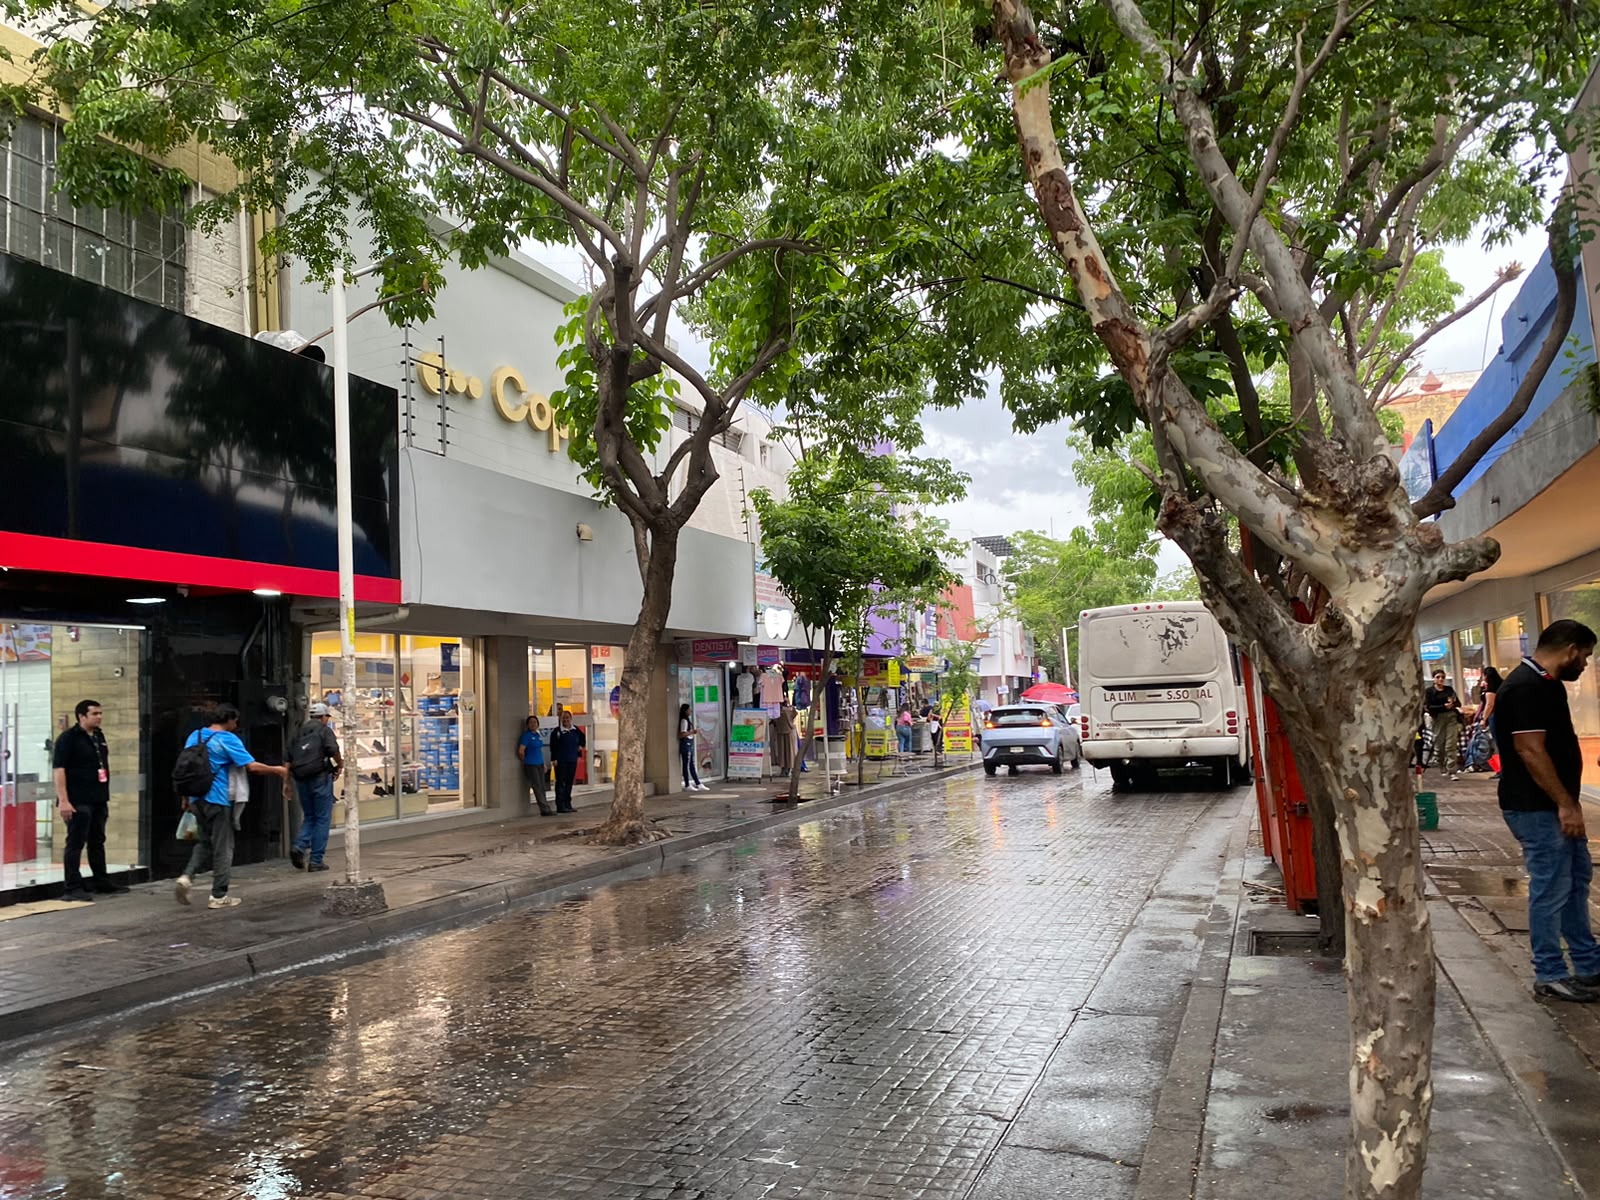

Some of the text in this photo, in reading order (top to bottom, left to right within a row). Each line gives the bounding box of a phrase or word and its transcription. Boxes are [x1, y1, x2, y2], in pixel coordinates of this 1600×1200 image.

[491, 366, 572, 452] Cop
[694, 641, 734, 652] DENTISTA
[758, 649, 777, 657] DENTISTA
[1104, 692, 1116, 702] LA
[1118, 691, 1139, 702] LIM
